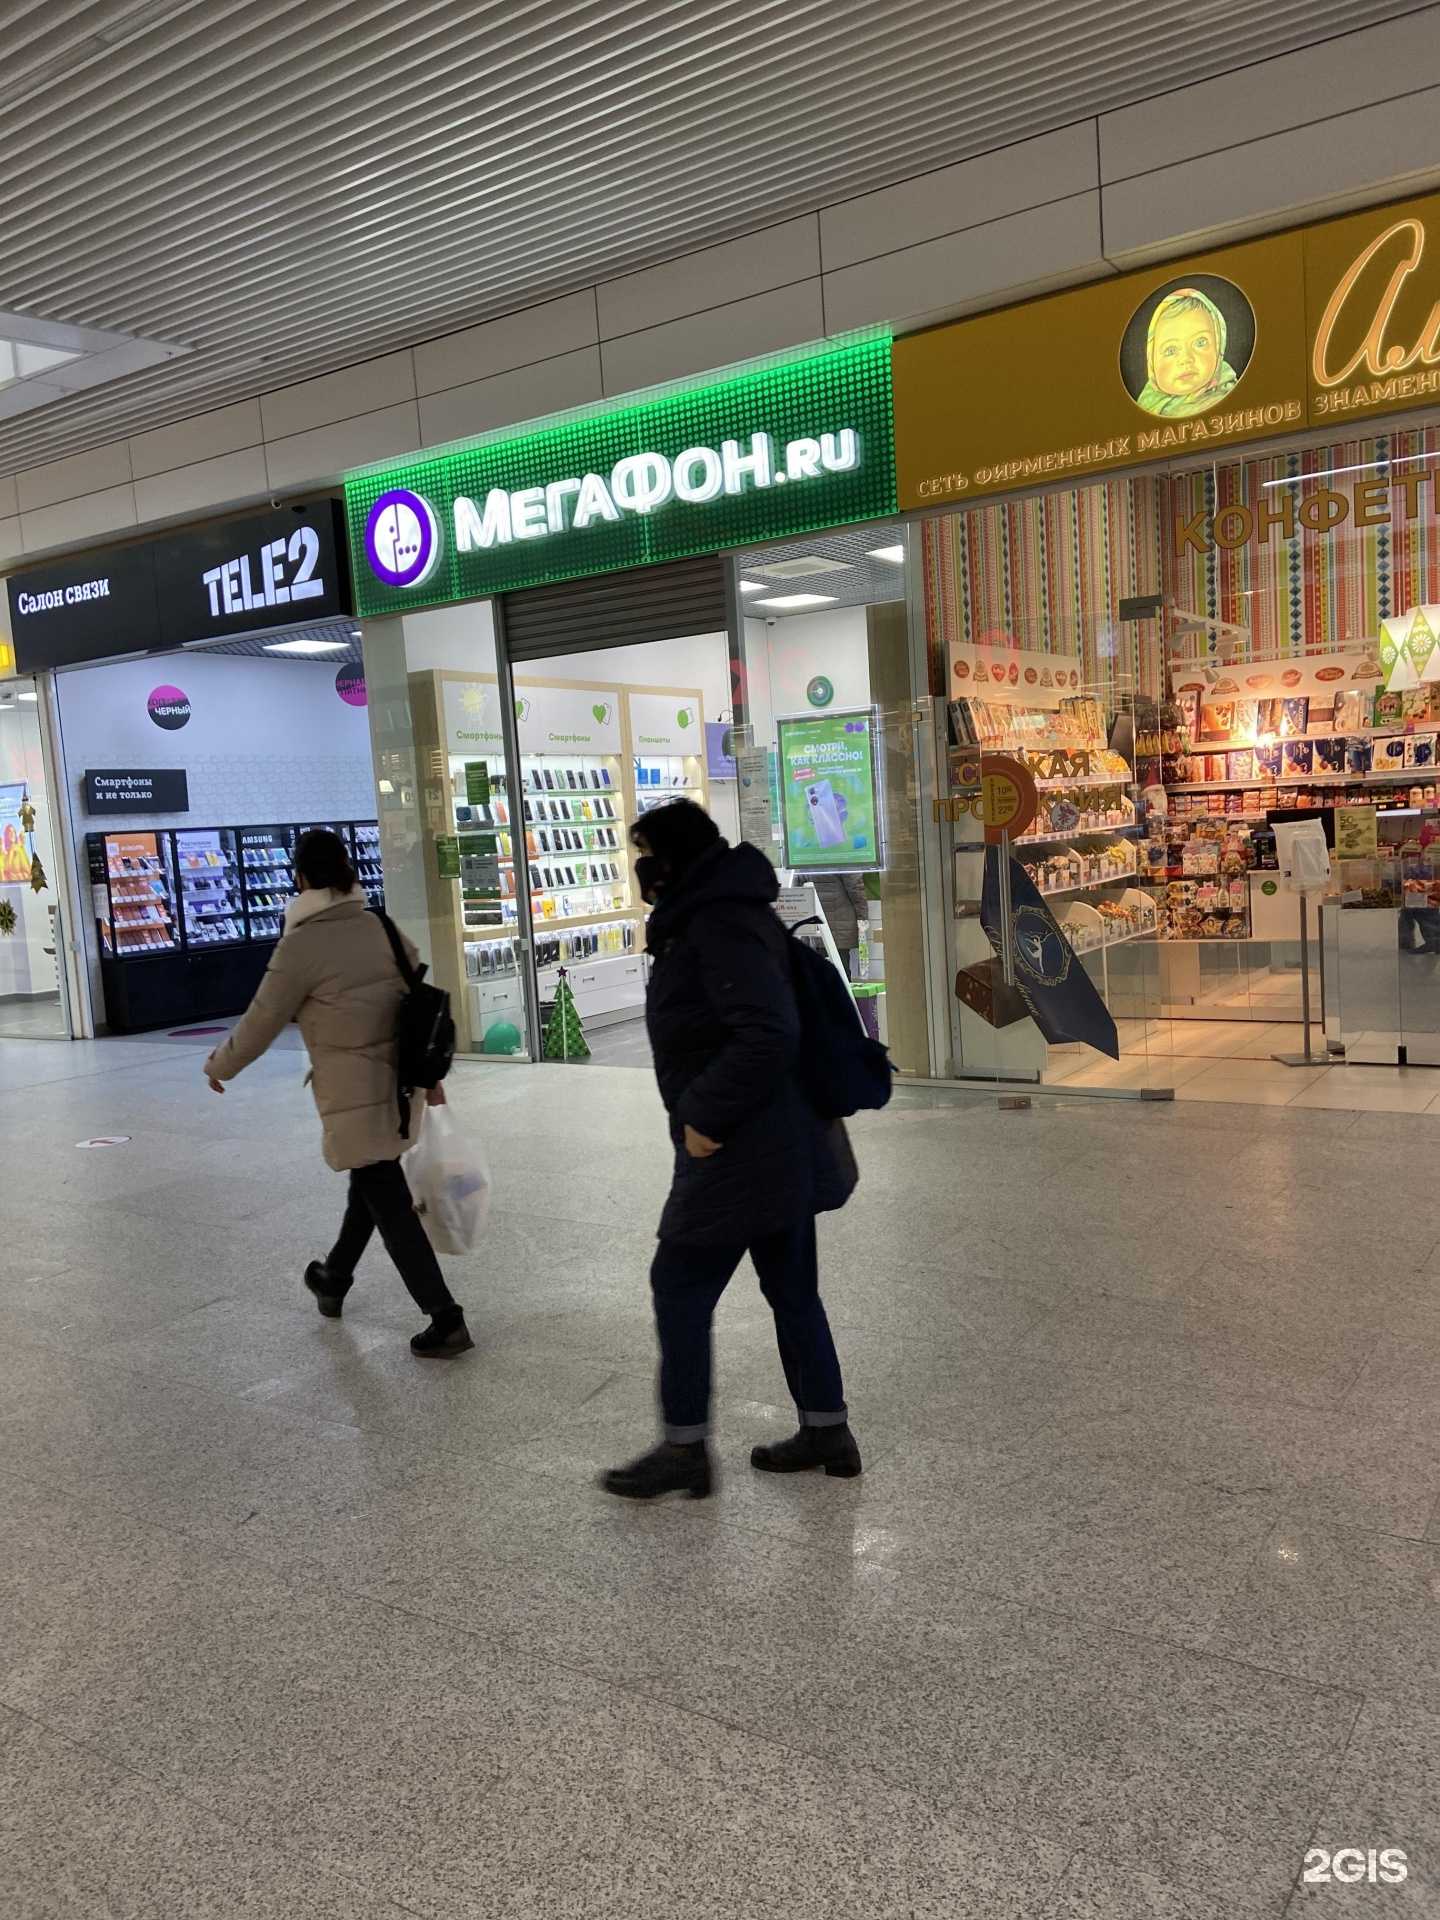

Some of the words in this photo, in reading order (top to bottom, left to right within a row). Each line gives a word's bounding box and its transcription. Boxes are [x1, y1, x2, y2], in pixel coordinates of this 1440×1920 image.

[918, 472, 969, 497] СЕТЬ
[974, 435, 1131, 484] ФИРМЕННЫХ
[1137, 400, 1302, 451] МАГАЗИНОВ
[1174, 468, 1440, 558] КОНФЕТ
[202, 526, 324, 617] TELE2
[18, 589, 64, 615] Салон
[65, 578, 110, 605] связи
[95, 776, 153, 789] Смартфоны
[96, 791, 103, 800] и
[105, 791, 118, 800] не
[119, 791, 153, 800] только
[242, 834, 273, 844] AMSUNG
